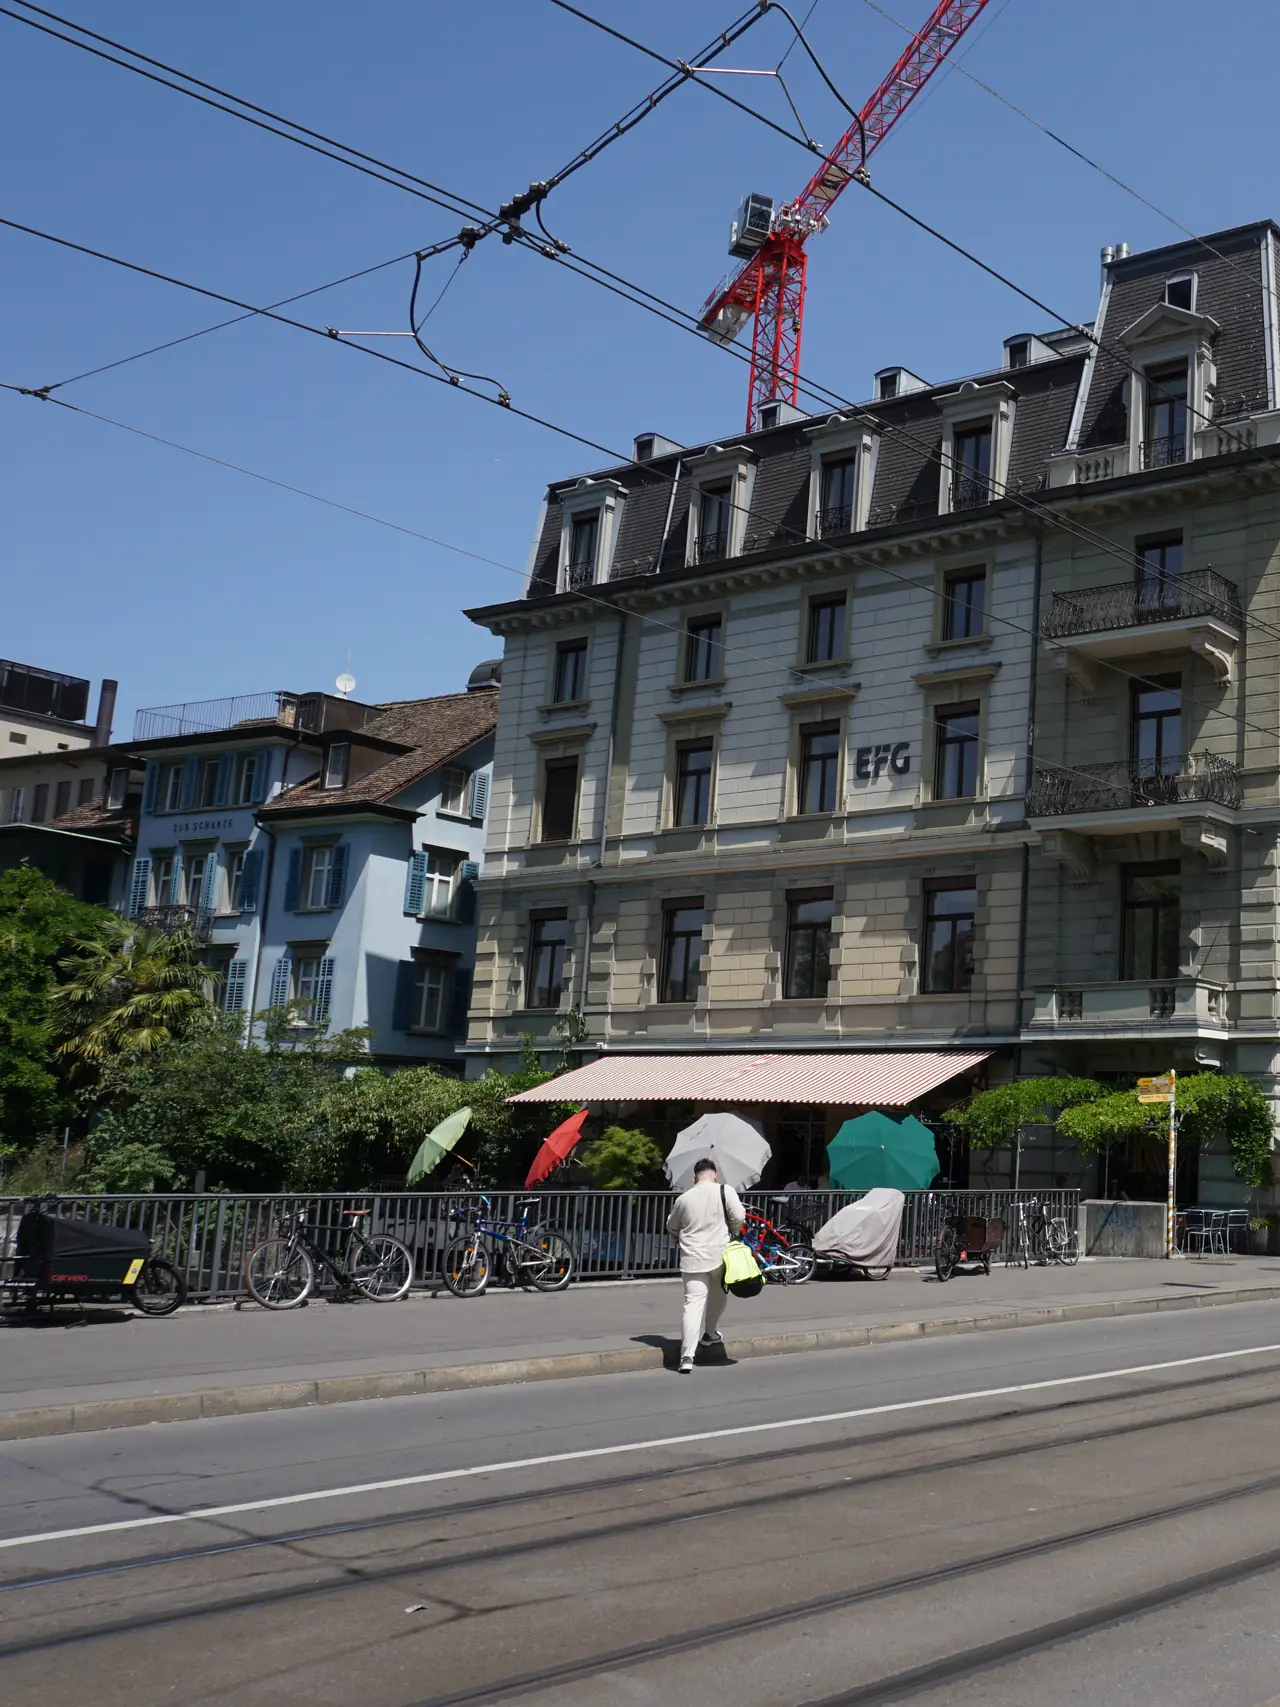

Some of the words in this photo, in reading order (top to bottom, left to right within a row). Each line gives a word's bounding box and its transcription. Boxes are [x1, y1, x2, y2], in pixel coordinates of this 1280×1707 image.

[856, 742, 910, 780] EFG
[173, 823, 189, 833] ZUR
[193, 819, 233, 832] SCHANZE
